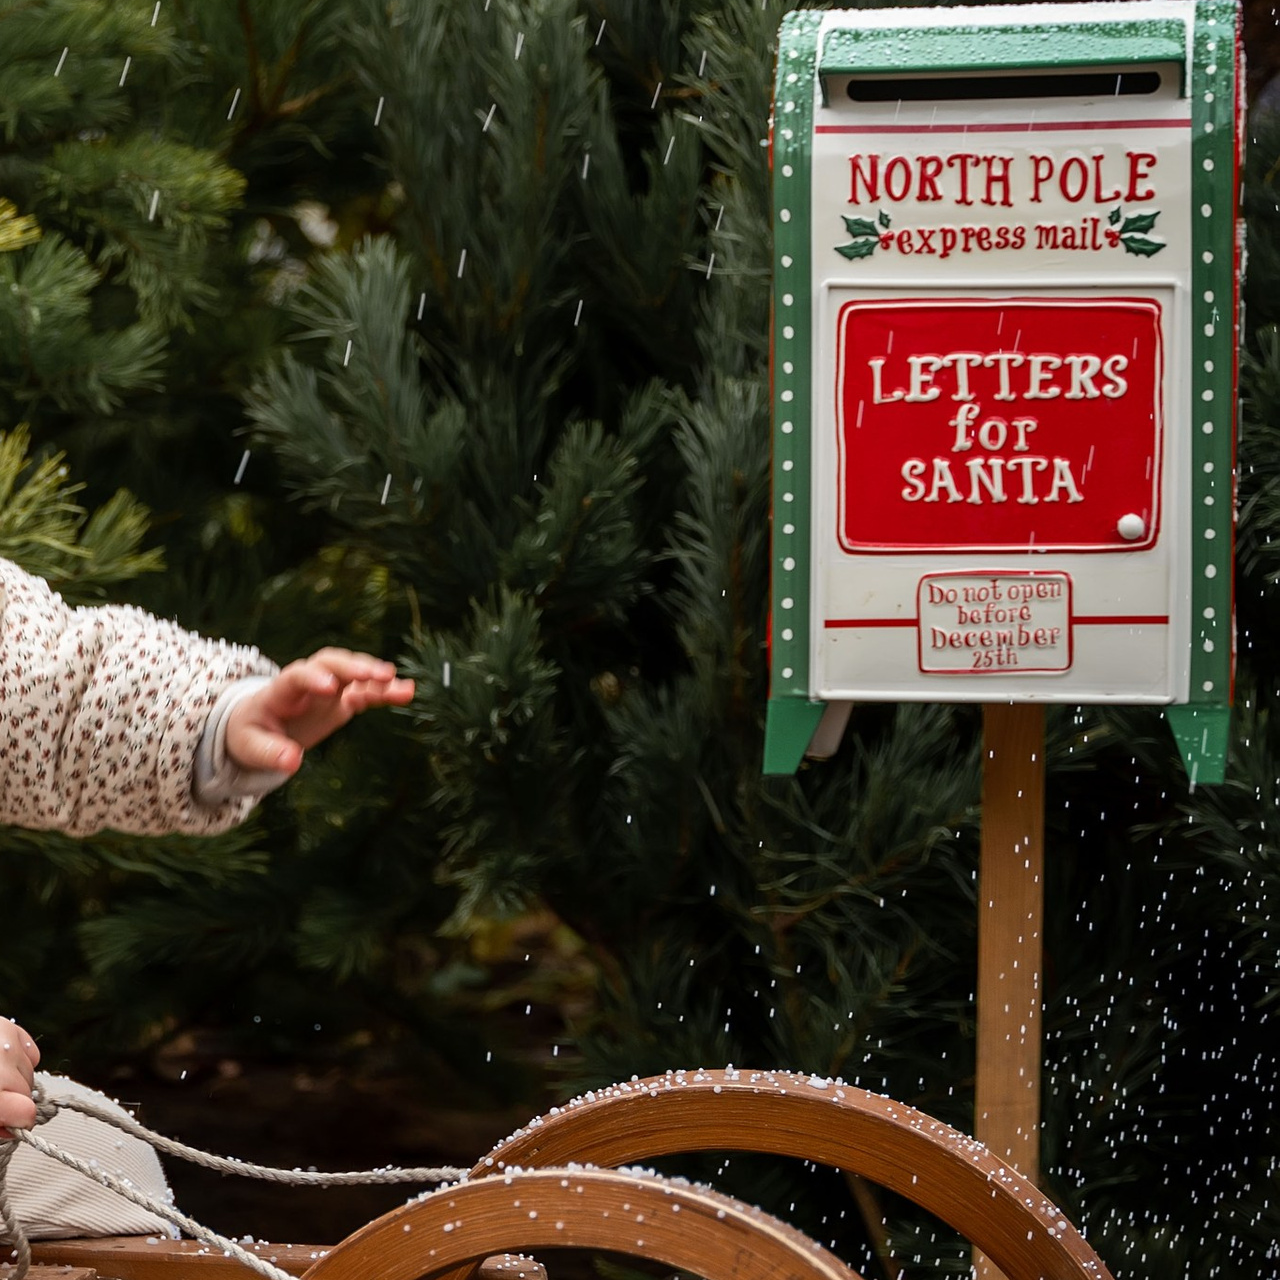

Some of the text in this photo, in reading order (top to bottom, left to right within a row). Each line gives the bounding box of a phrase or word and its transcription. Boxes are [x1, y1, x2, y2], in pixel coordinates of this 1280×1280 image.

[848, 152, 1157, 207] NORTH POLE
[897, 217, 1102, 259] express mail
[868, 352, 1129, 404] LETTERS
[948, 403, 1038, 452] for
[901, 455, 1084, 505] SANTA
[928, 579, 1062, 604] Do not open
[957, 602, 1031, 625] before
[931, 624, 1060, 650] December
[972, 648, 1018, 669] 25th
